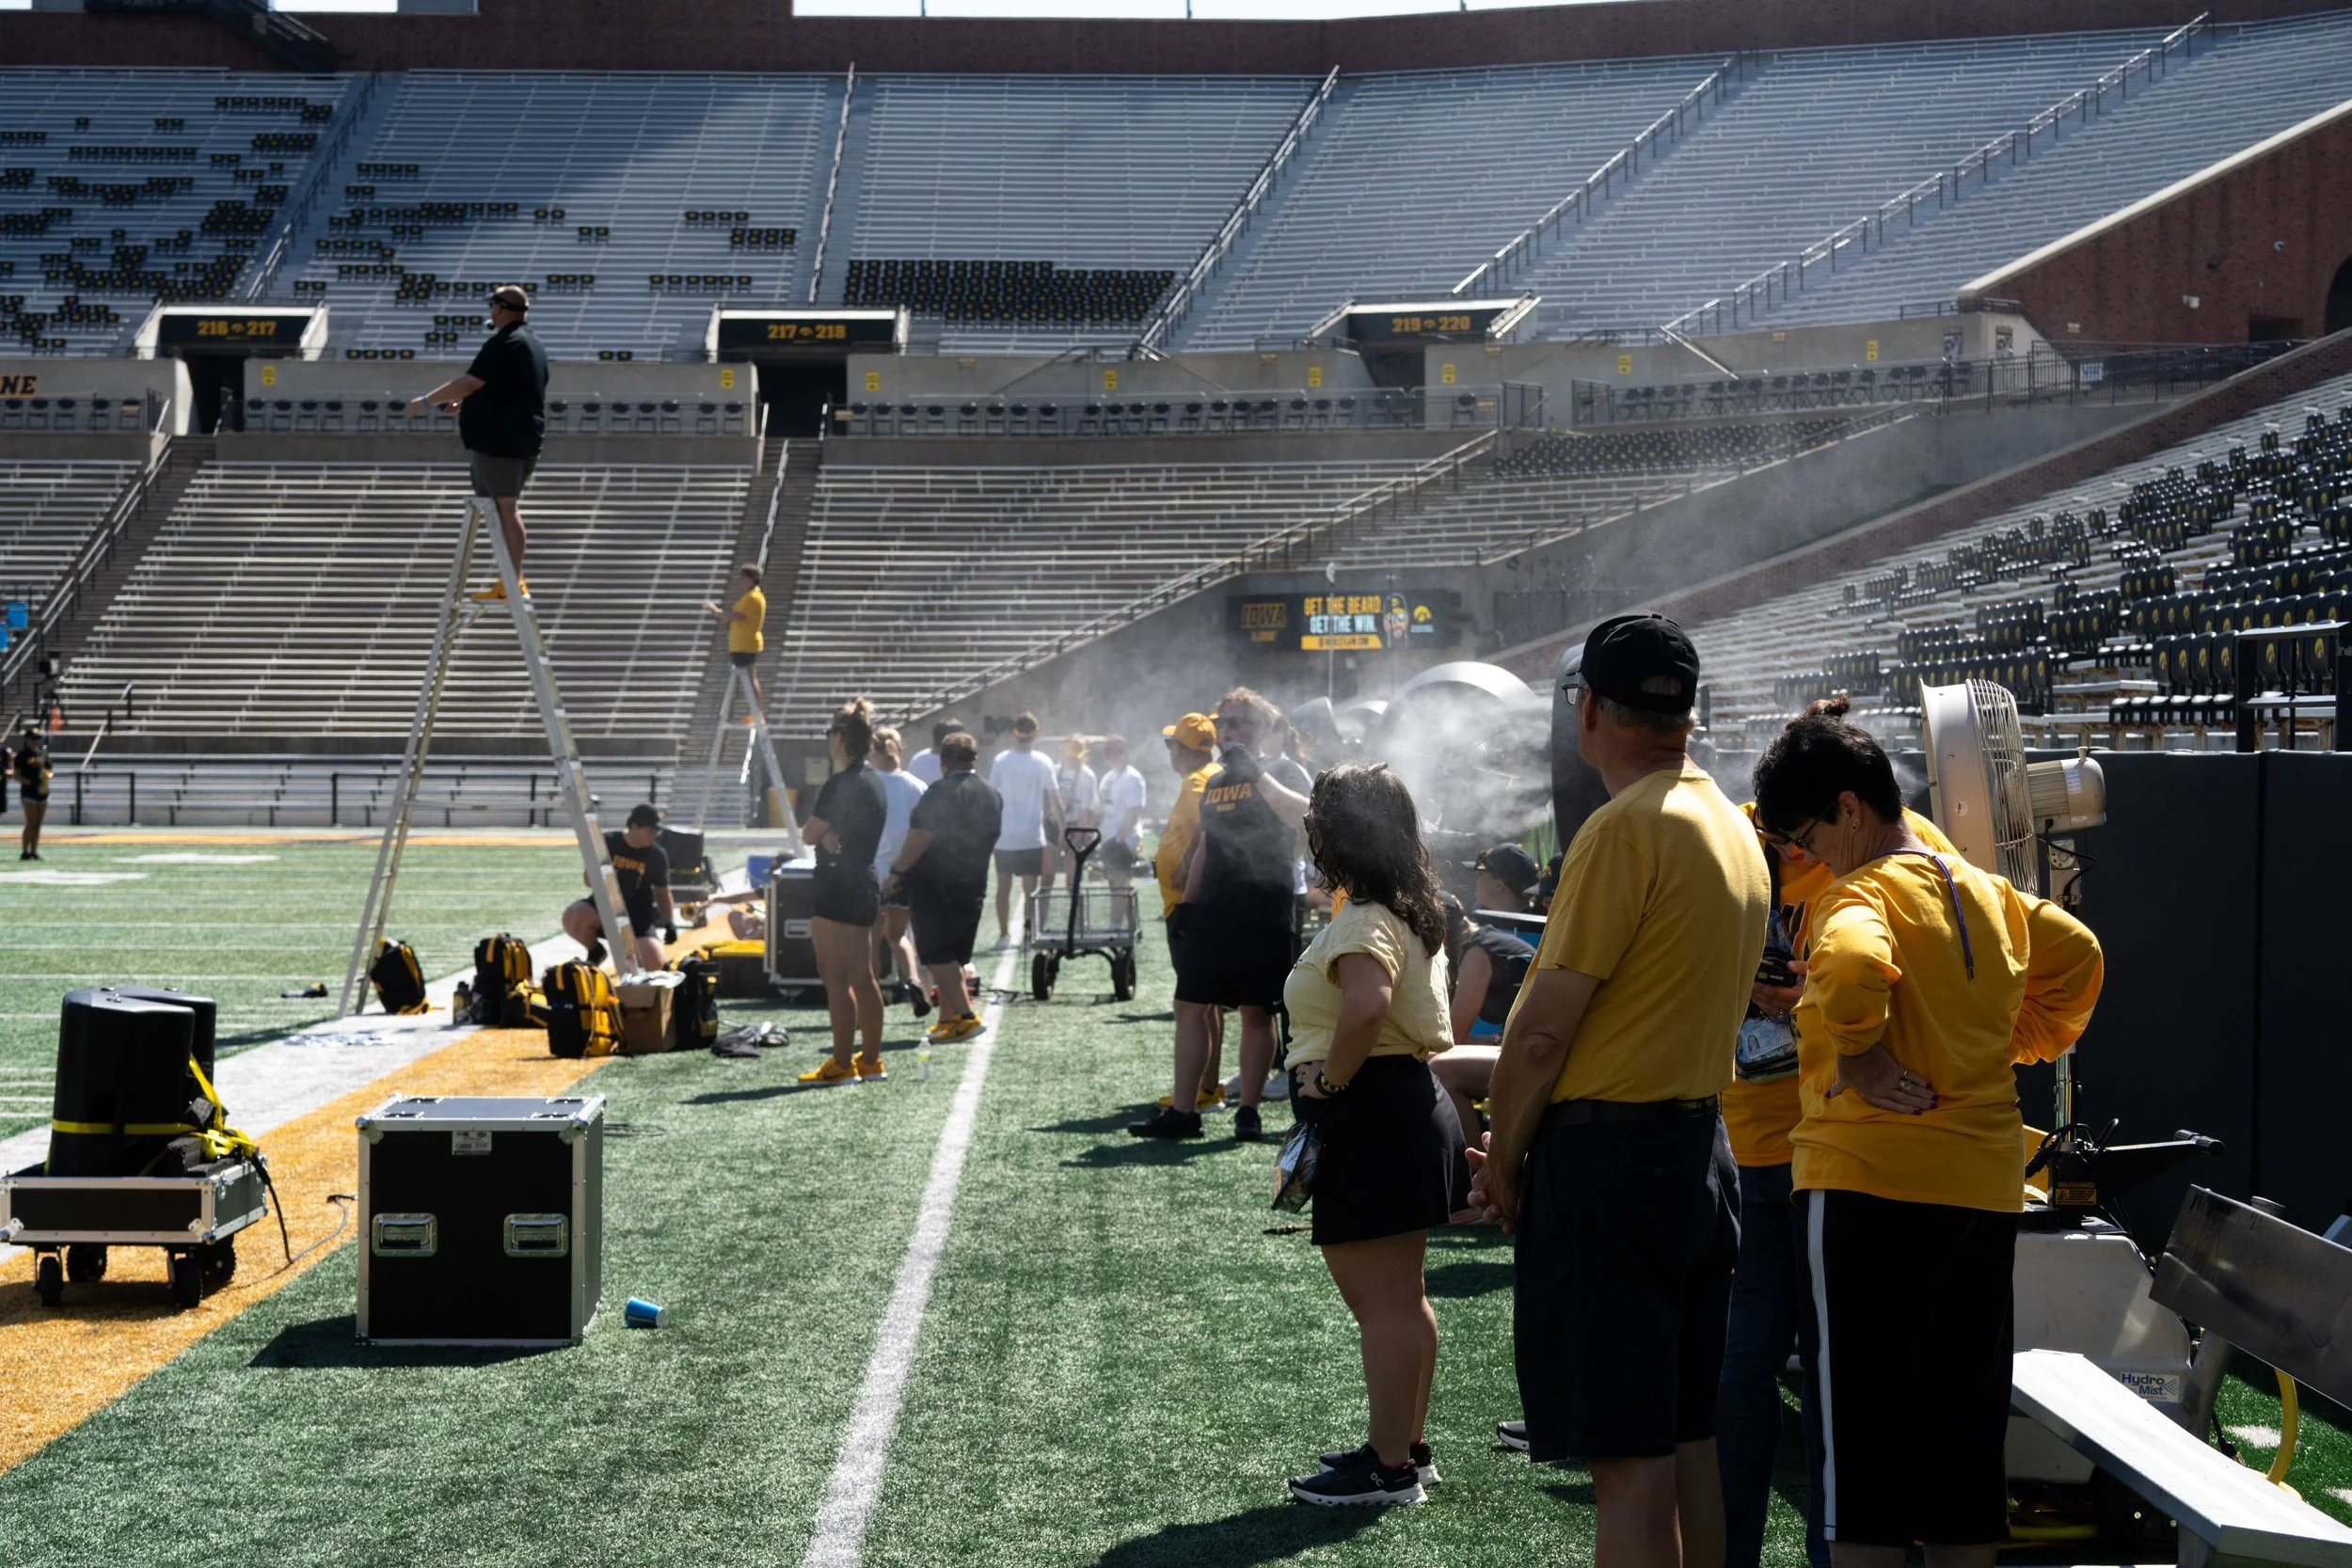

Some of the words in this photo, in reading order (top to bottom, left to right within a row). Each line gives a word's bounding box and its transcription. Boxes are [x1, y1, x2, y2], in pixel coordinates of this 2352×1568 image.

[198, 321, 228, 336] 216
[246, 321, 277, 336] 217
[767, 324, 797, 340] 217
[815, 324, 847, 340] 218
[1392, 317, 1422, 333] 219
[1438, 315, 1471, 331] 220
[1304, 597, 1323, 616] GET
[1326, 595, 1345, 614] THE
[1241, 603, 1286, 628] IOWA
[1310, 614, 1328, 634] GET
[1331, 614, 1352, 633] THE
[1204, 783, 1252, 805] IOWA
[2122, 1373, 2165, 1386] Hydro
[2138, 1385, 2164, 1396] Mist
